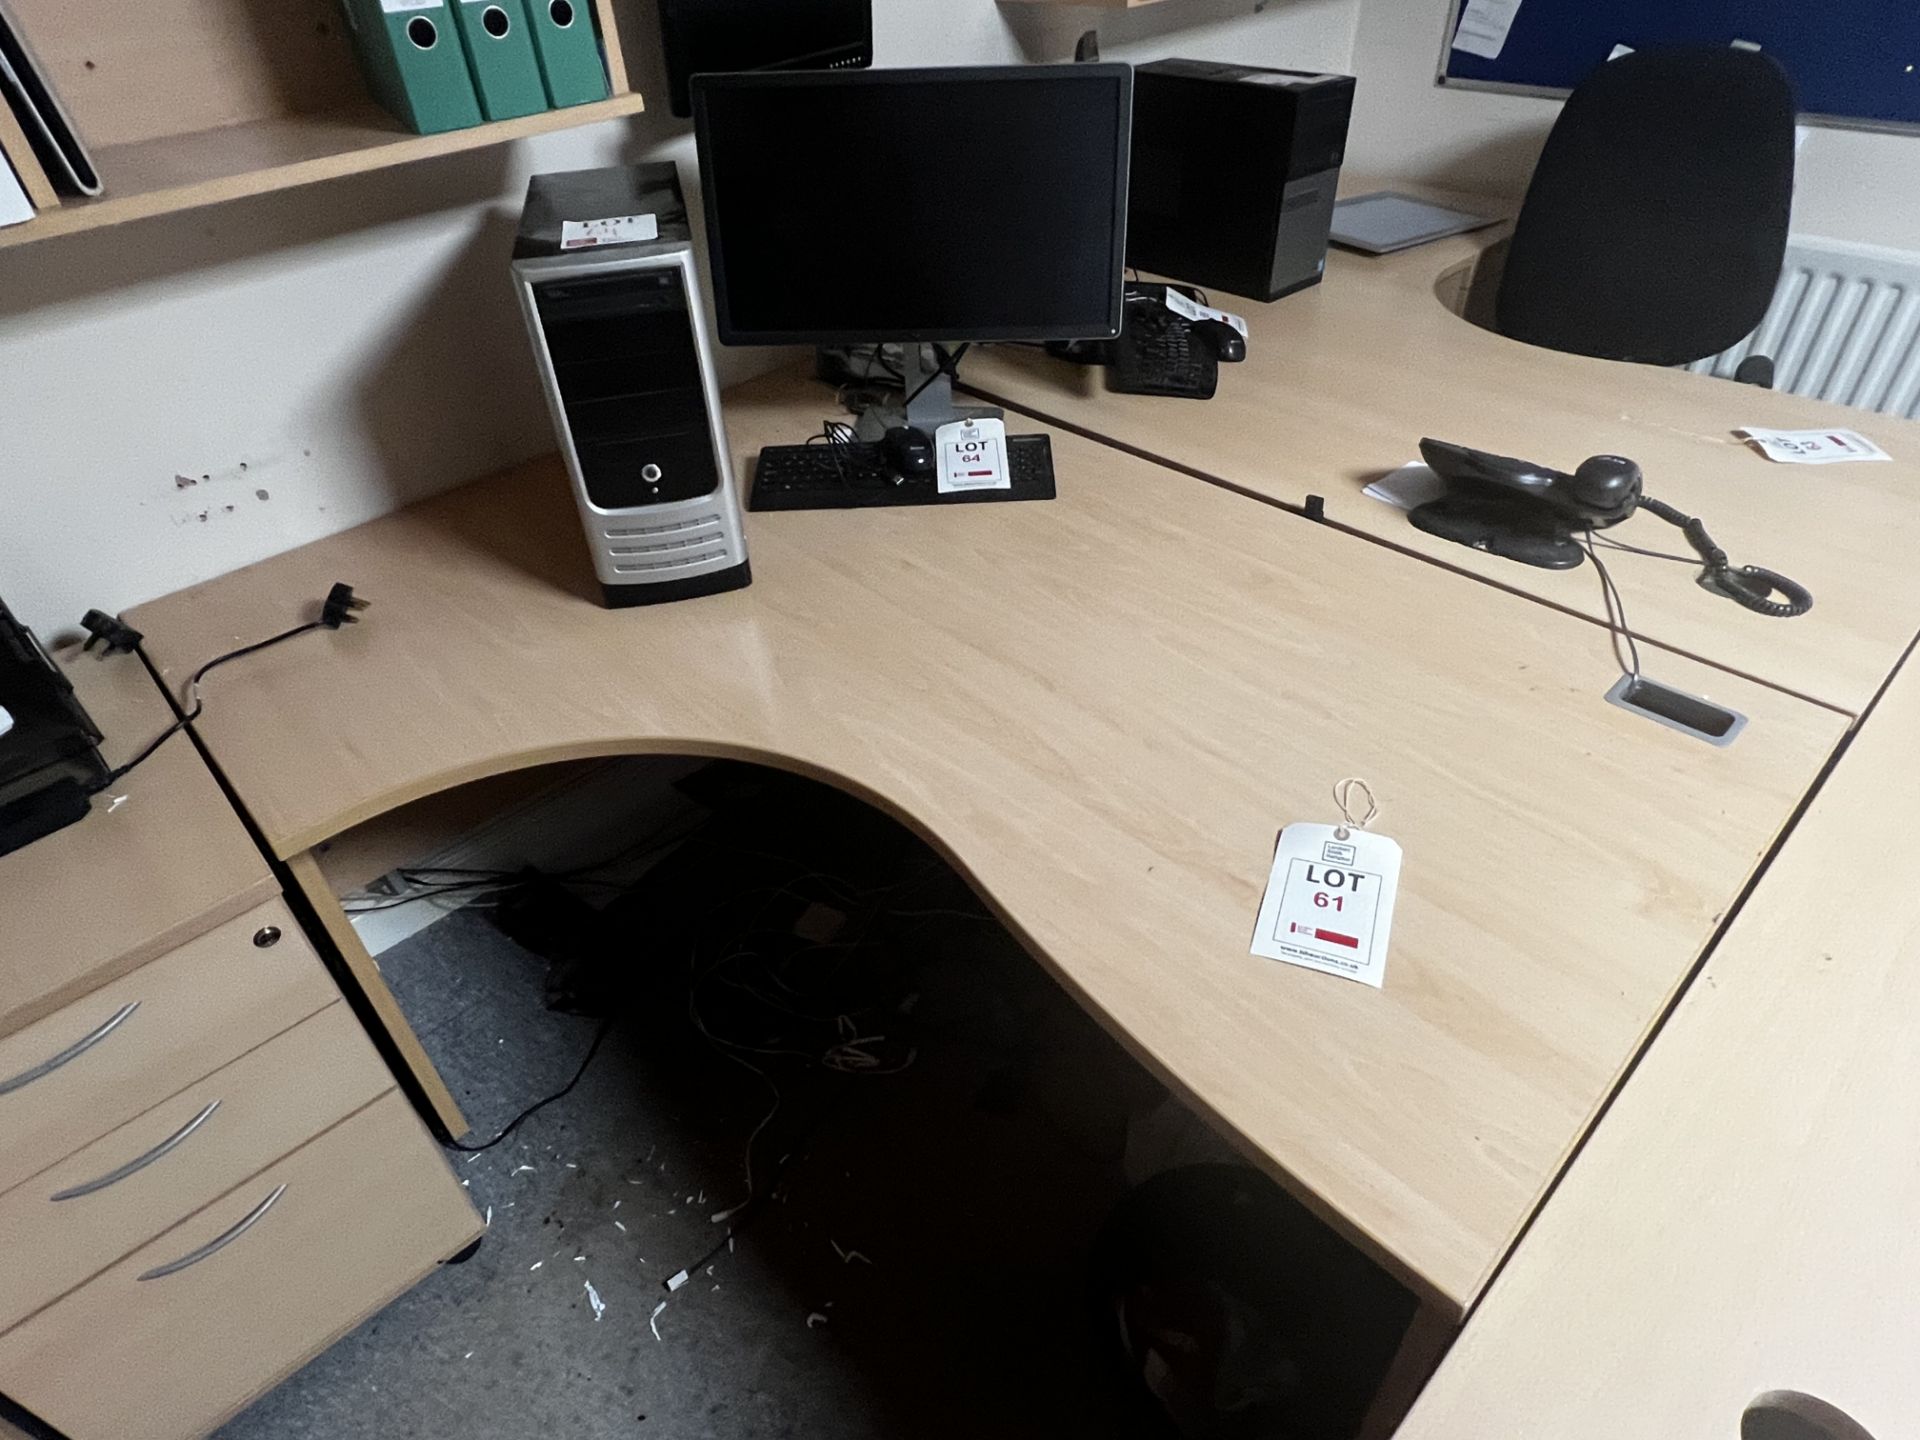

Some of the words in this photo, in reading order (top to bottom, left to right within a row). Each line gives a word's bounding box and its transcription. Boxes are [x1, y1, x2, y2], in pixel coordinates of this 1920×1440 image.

[955, 441, 988, 453] LOT
[1775, 437, 1806, 454] LOT
[962, 454, 981, 463] 64
[1306, 864, 1365, 892] LOT
[1313, 891, 1344, 912] 61
